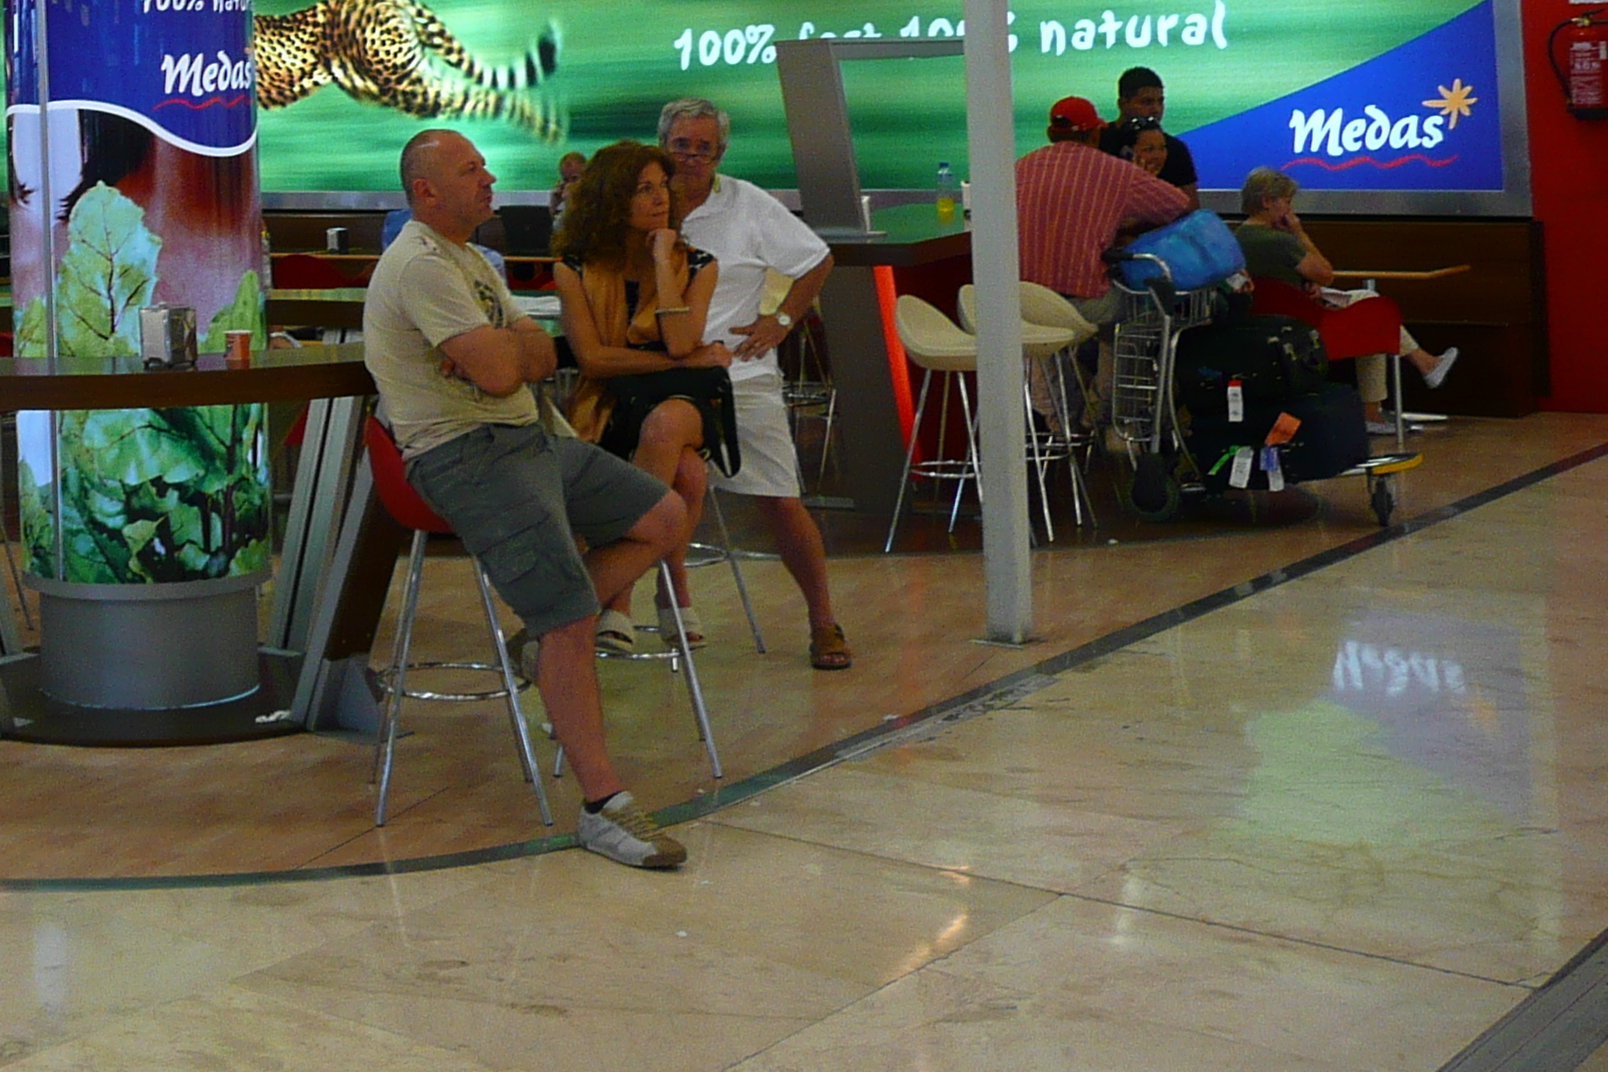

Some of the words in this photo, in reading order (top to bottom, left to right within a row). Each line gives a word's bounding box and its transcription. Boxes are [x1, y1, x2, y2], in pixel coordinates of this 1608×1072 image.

[674, 24, 777, 70] 100%
[1040, 0, 1228, 56] natural
[160, 50, 252, 97] Medas
[1289, 104, 1444, 156] Medas
